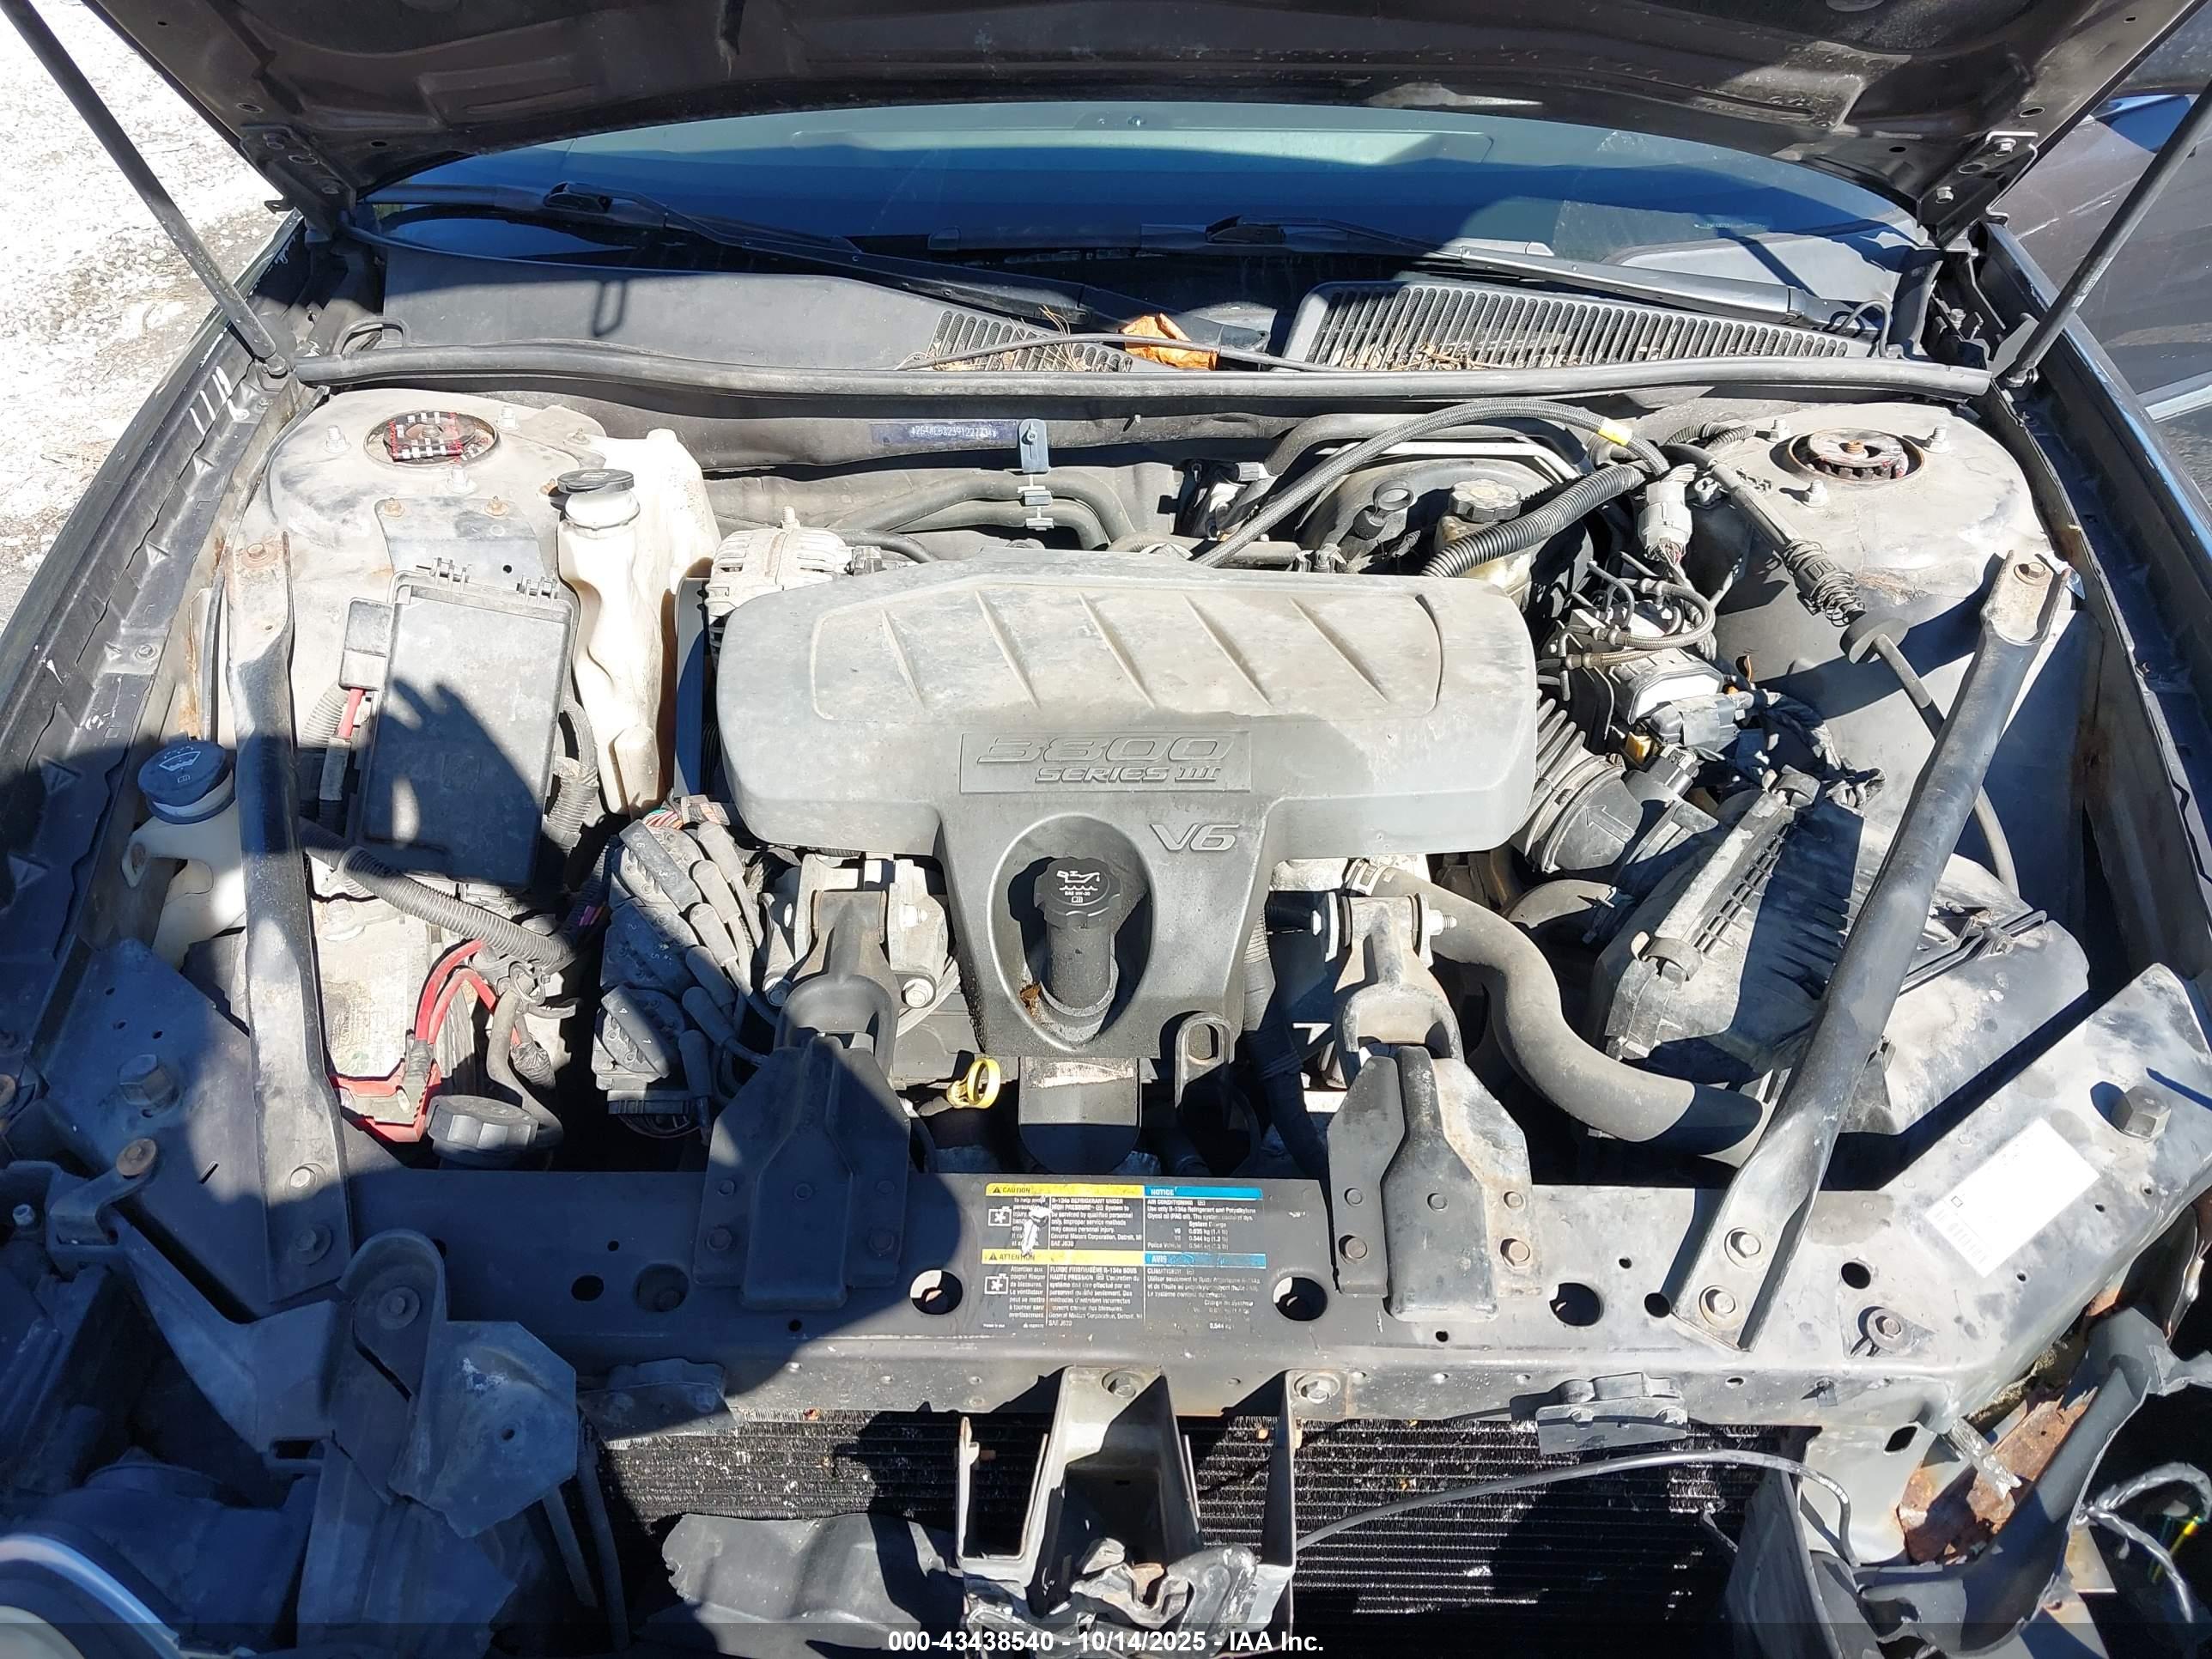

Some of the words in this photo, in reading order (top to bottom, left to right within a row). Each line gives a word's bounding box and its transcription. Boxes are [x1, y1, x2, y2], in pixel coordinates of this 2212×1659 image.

[976, 736, 1233, 763] 3800
[1035, 766, 1169, 782] SERIES
[1150, 823, 1241, 852] V6
[1152, 1255, 1168, 1263] AVIS
